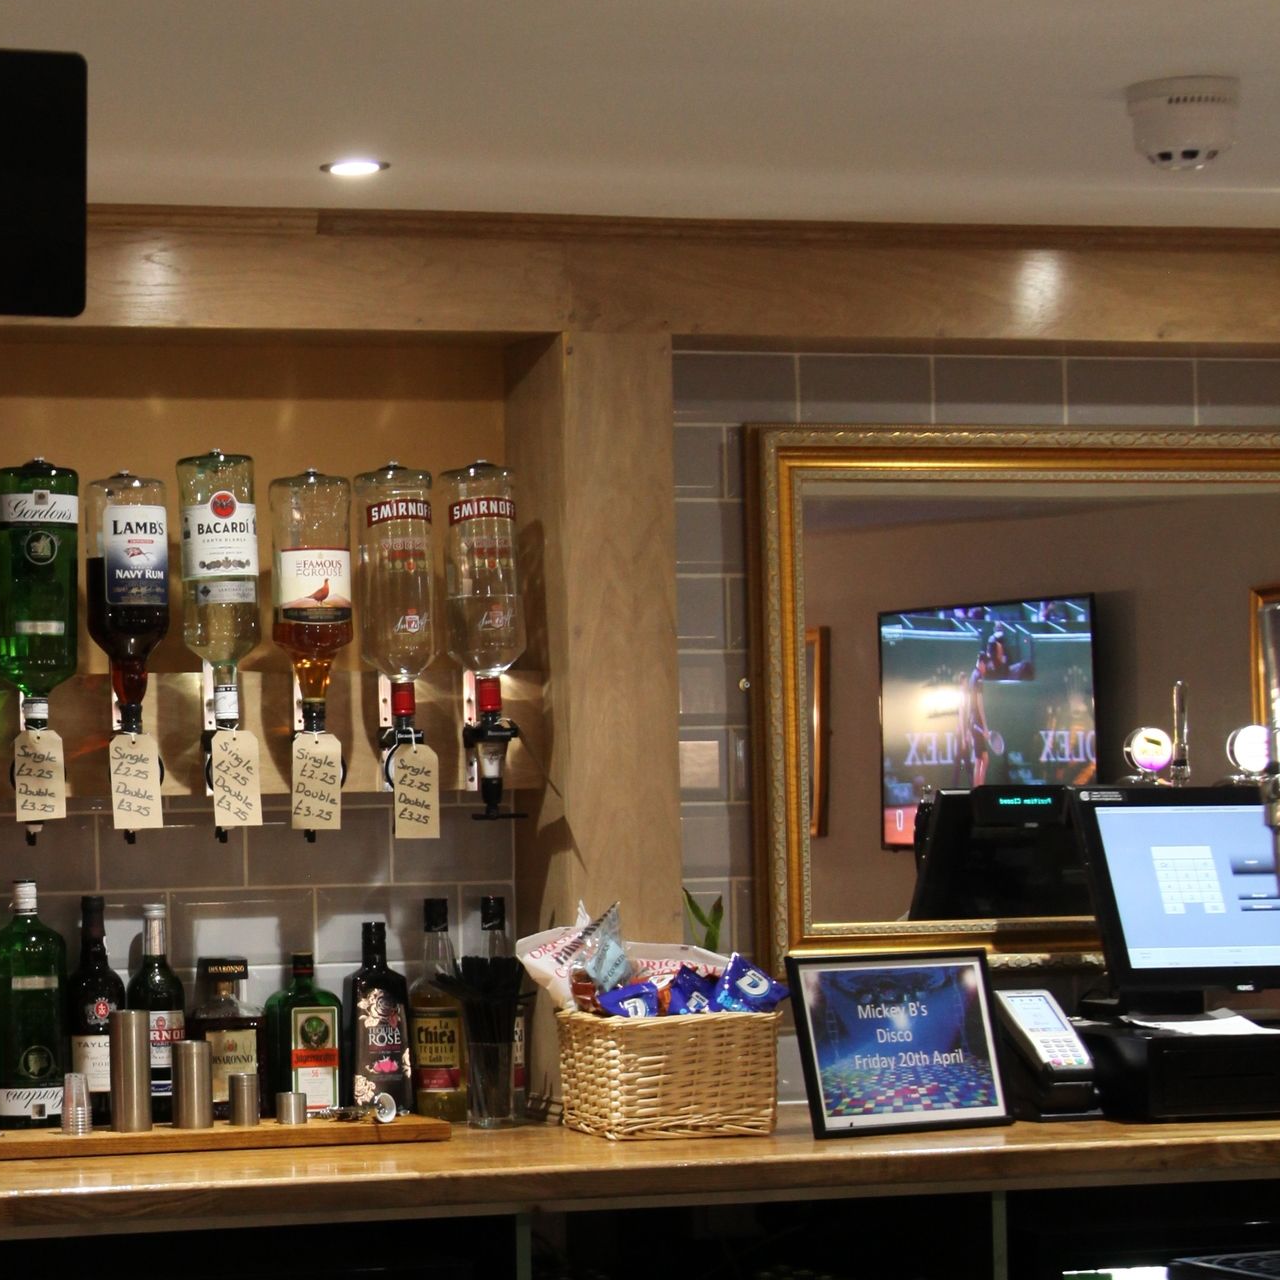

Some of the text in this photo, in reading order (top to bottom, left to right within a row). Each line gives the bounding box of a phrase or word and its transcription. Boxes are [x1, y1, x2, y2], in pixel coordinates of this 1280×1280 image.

[8, 500, 73, 521] Gordon's
[112, 520, 164, 536] LAMB'S
[197, 519, 249, 534] BACARDÍ
[303, 560, 342, 569] FAMOUS
[303, 568, 342, 577] GROUSE
[115, 570, 143, 579] NAVY
[17, 745, 56, 763] Single
[112, 747, 150, 764] Single
[220, 742, 254, 776] Single
[296, 748, 335, 769] Single
[397, 759, 432, 777] Single
[18, 782, 56, 797] Double
[115, 782, 154, 801] Double
[215, 776, 253, 810] Double
[295, 782, 338, 805] Double
[398, 793, 431, 810] Double
[208, 965, 245, 974] DISARONNO
[857, 1001, 928, 1020] Mickey B's
[369, 1033, 402, 1047] ROSE
[876, 1028, 913, 1043] Disco
[854, 1048, 964, 1071] Friday 20th April
